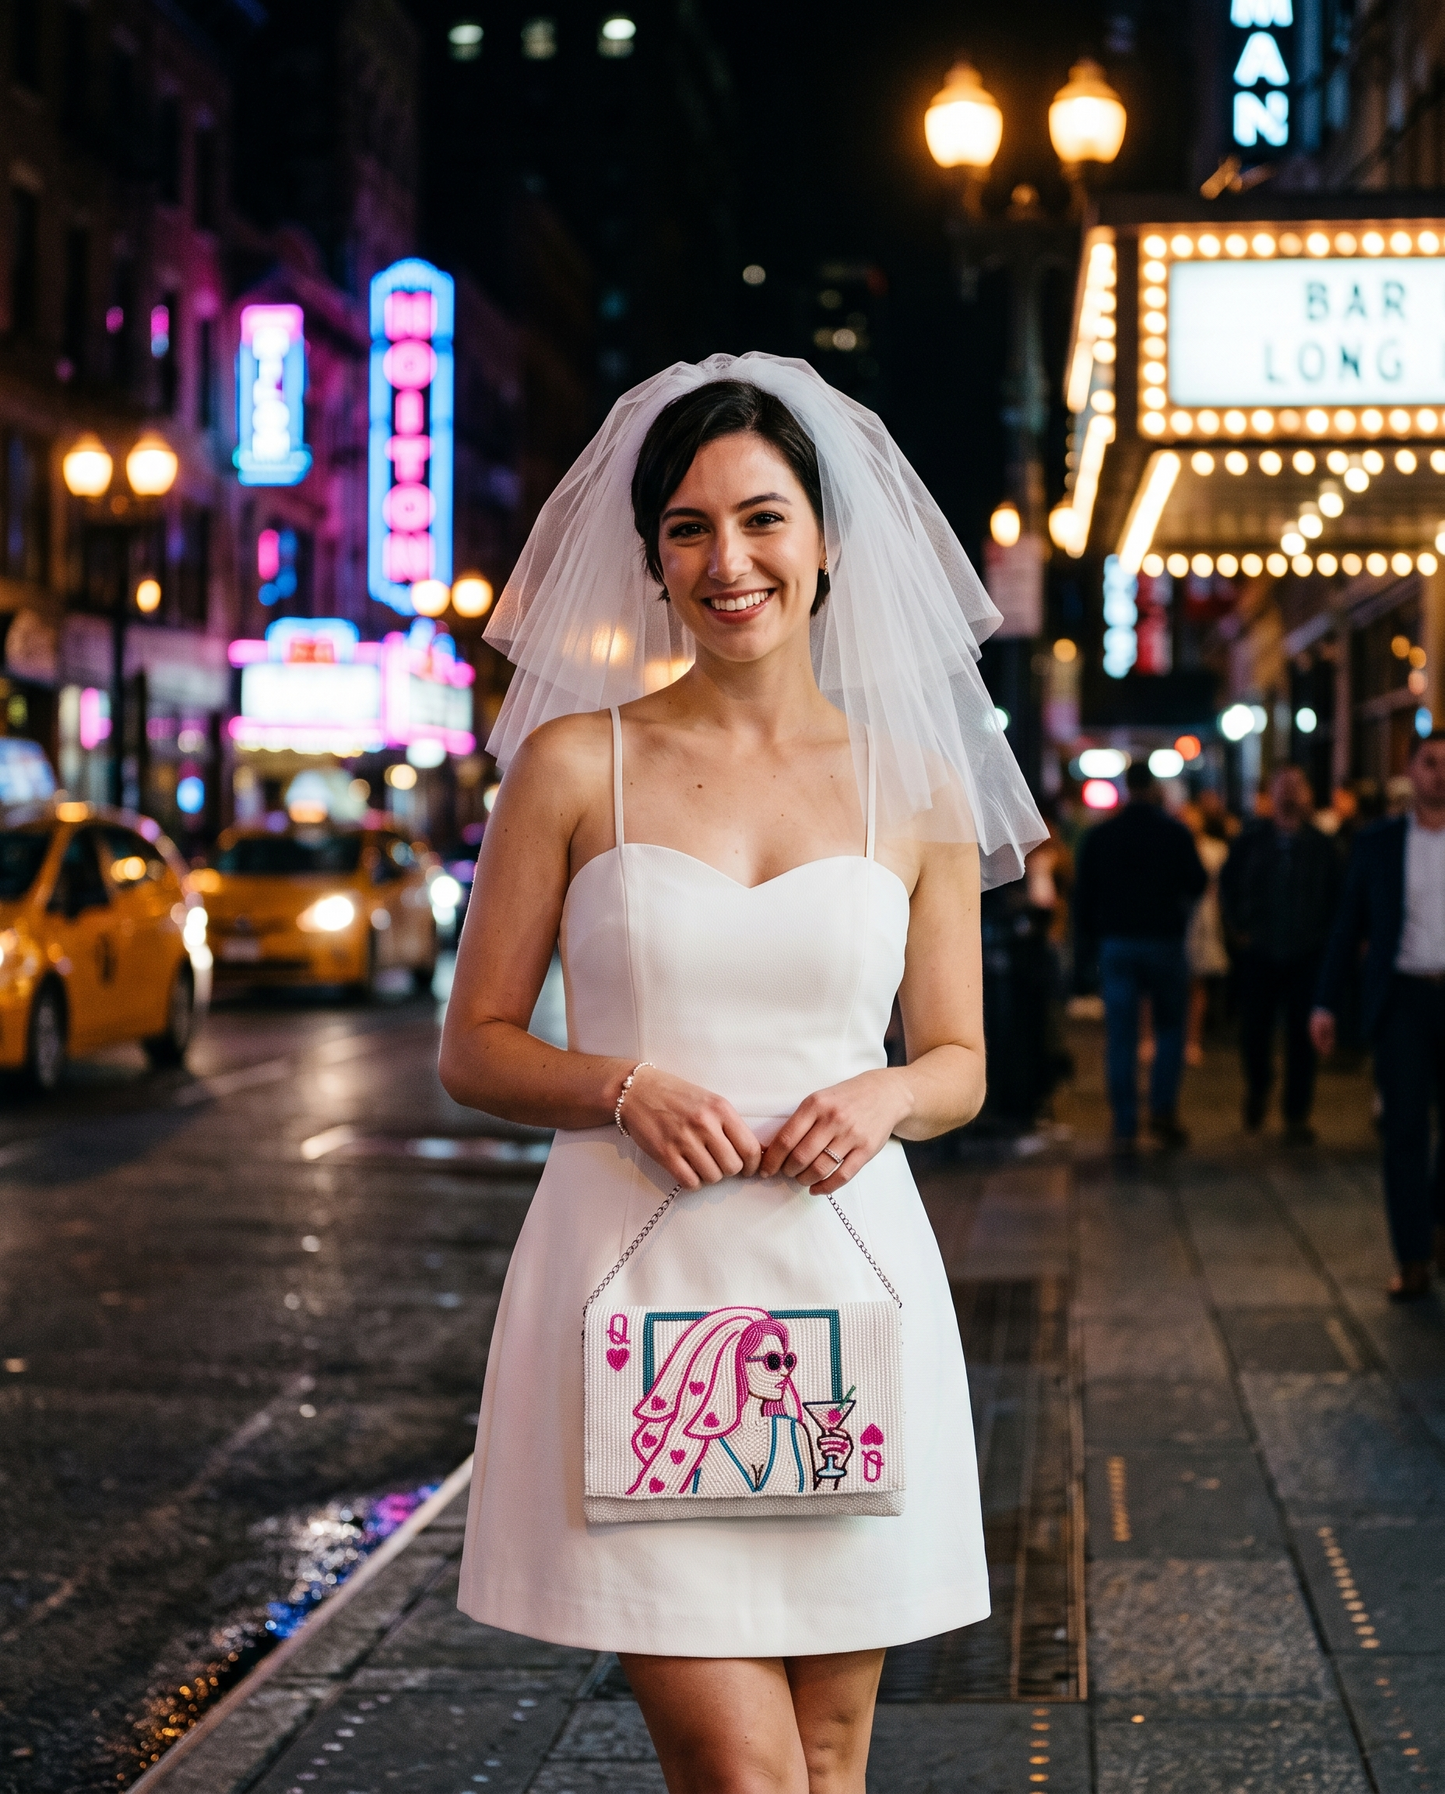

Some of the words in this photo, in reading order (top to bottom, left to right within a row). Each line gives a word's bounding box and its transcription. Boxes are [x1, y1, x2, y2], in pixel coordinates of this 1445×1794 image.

[1305, 279, 1406, 322] BAR
[1263, 339, 1404, 384] LONG
[607, 1314, 630, 1344] Q
[861, 1450, 883, 1482] Q
